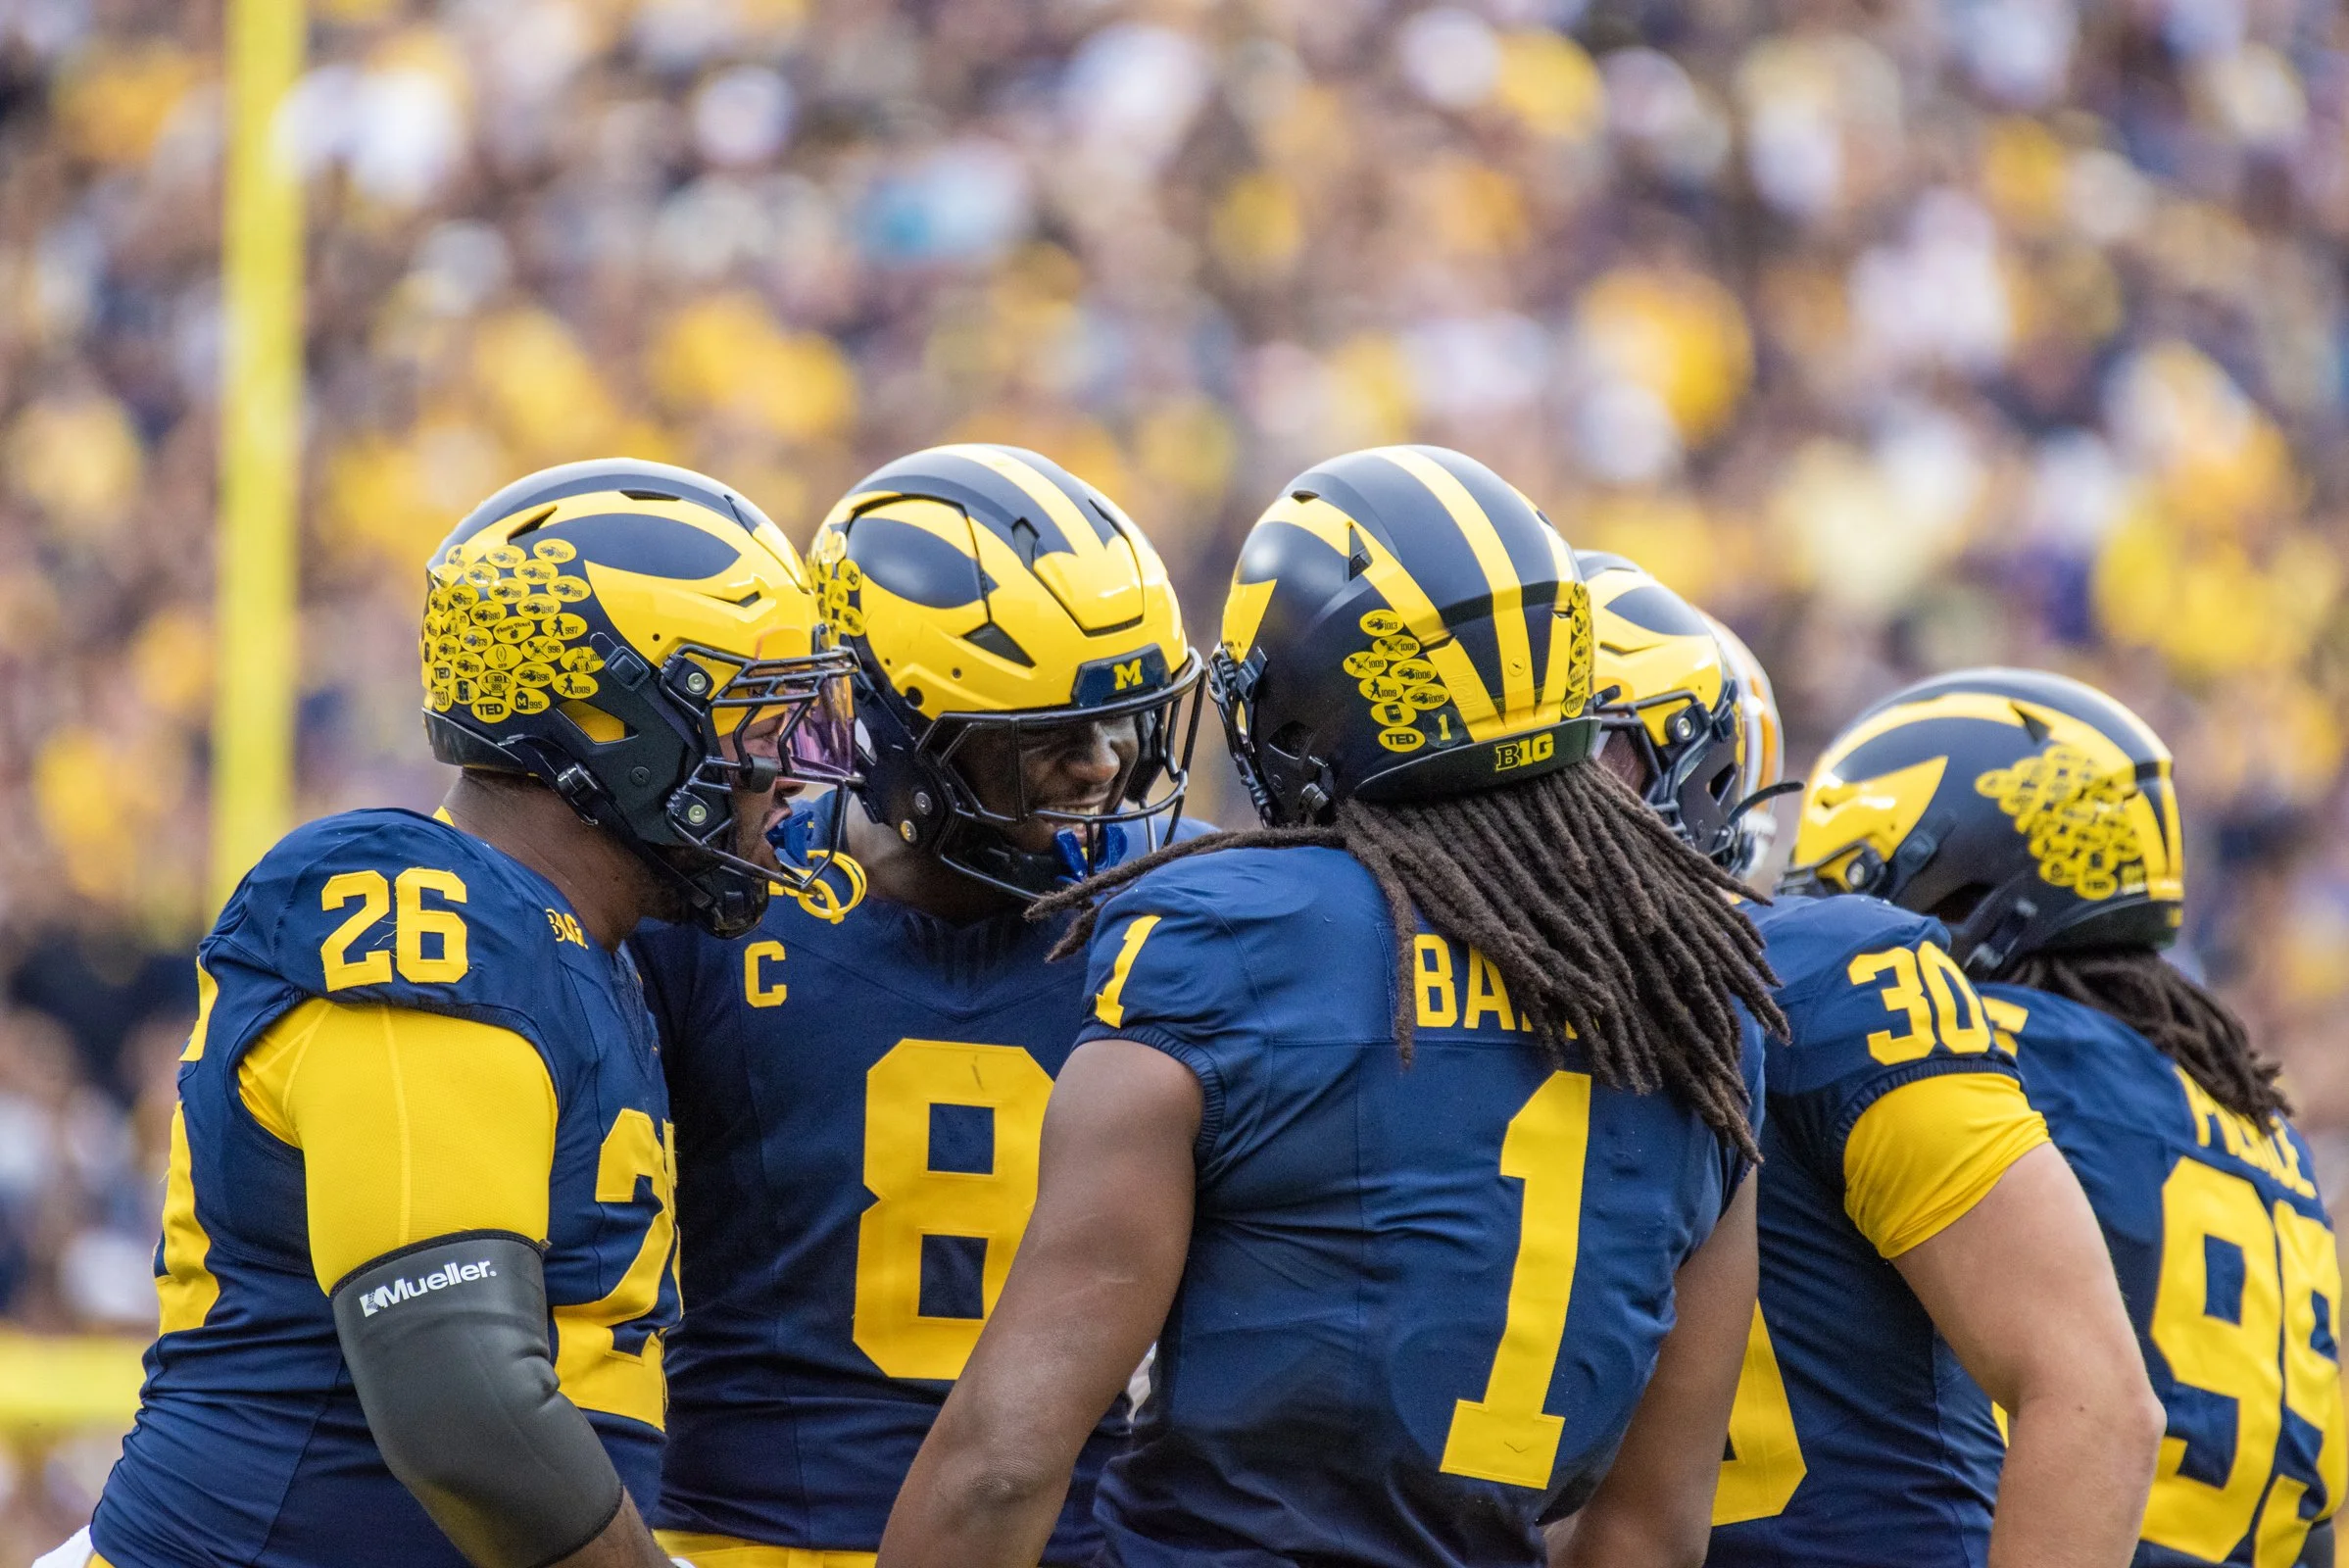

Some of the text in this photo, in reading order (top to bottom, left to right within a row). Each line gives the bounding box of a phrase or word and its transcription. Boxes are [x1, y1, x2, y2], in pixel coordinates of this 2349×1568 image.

[564, 626, 578, 635] 997
[1384, 621, 1398, 630] 1013
[1399, 642, 1417, 652] 1006
[434, 666, 451, 679] TED
[1113, 658, 1144, 691] M
[1414, 671, 1432, 680] 1006
[476, 703, 504, 716] TED
[1385, 733, 1417, 745] TED
[1438, 713, 1451, 741] 1
[319, 867, 470, 993] 26
[744, 940, 787, 1007] C
[1095, 914, 1162, 1029] 1
[1847, 940, 1991, 1066] 30
[852, 1038, 1055, 1380] 8
[1440, 1069, 1591, 1490] 1
